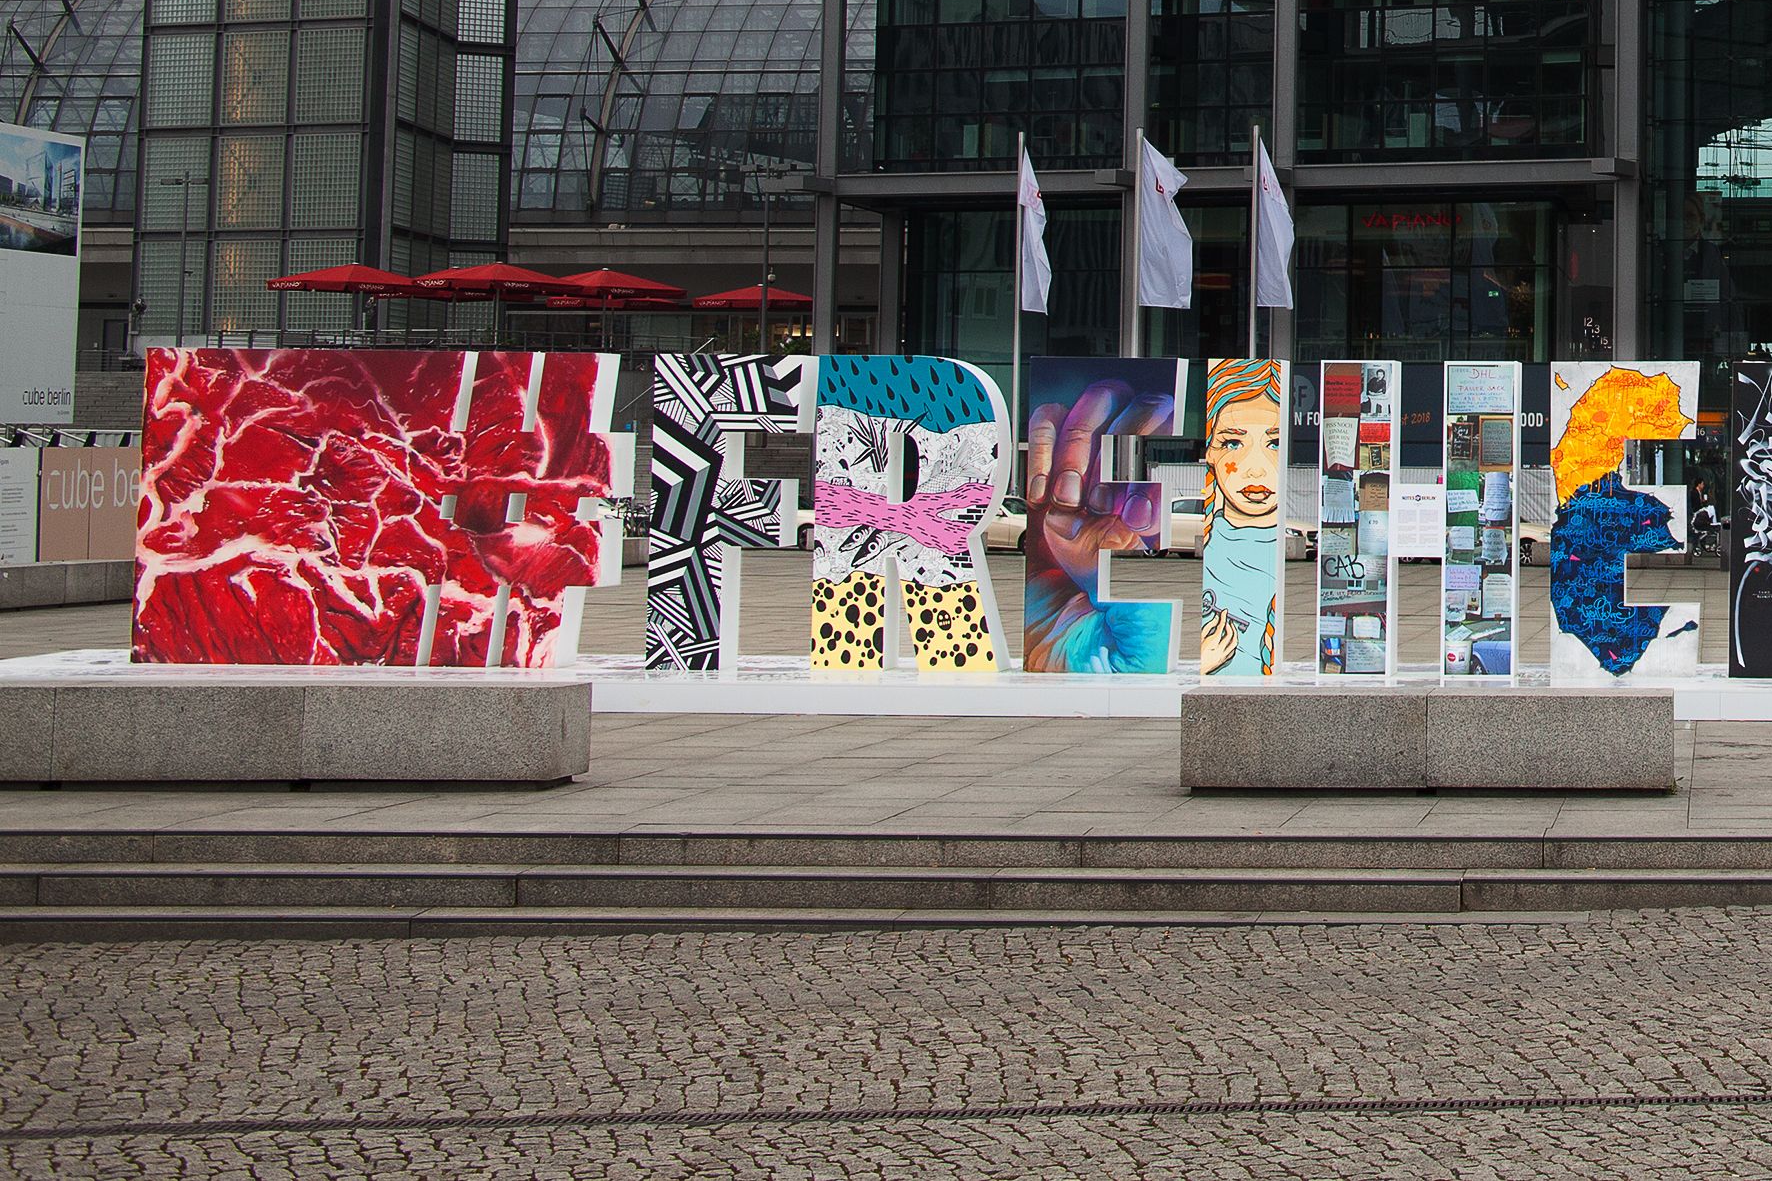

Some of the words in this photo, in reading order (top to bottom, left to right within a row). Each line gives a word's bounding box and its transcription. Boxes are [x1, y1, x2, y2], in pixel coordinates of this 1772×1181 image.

[1361, 210, 1462, 232] VAPIANO
[1583, 316, 1593, 327] 12
[22, 387, 45, 406] cube
[47, 387, 72, 406] berlin
[1697, 427, 1706, 436] 16
[46, 459, 105, 510] cube
